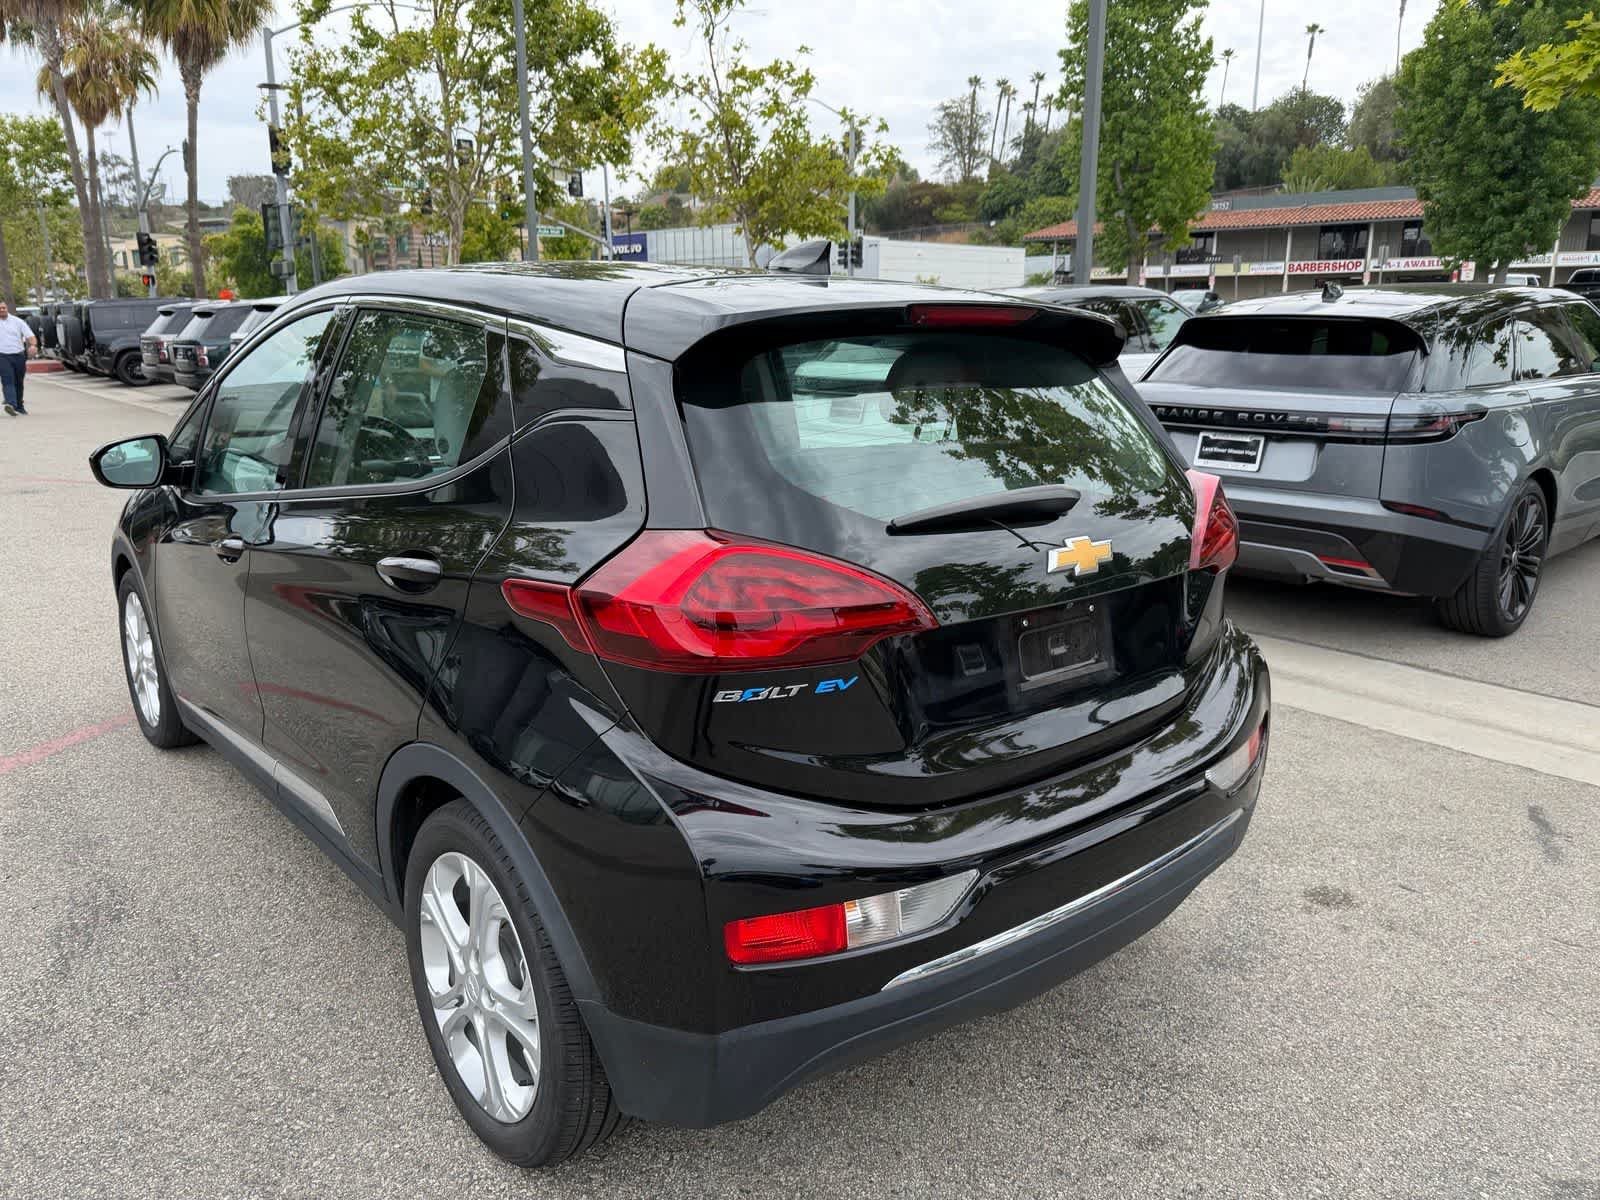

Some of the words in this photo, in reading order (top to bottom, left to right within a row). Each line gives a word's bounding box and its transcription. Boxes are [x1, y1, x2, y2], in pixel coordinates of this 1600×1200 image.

[612, 244, 642, 255] VOLVO
[1288, 261, 1362, 273] BARBERSHOP
[1155, 407, 1225, 420] RANGE
[1236, 412, 1320, 426] ROVER
[713, 683, 809, 703] BOLT
[815, 676, 859, 694] EV
